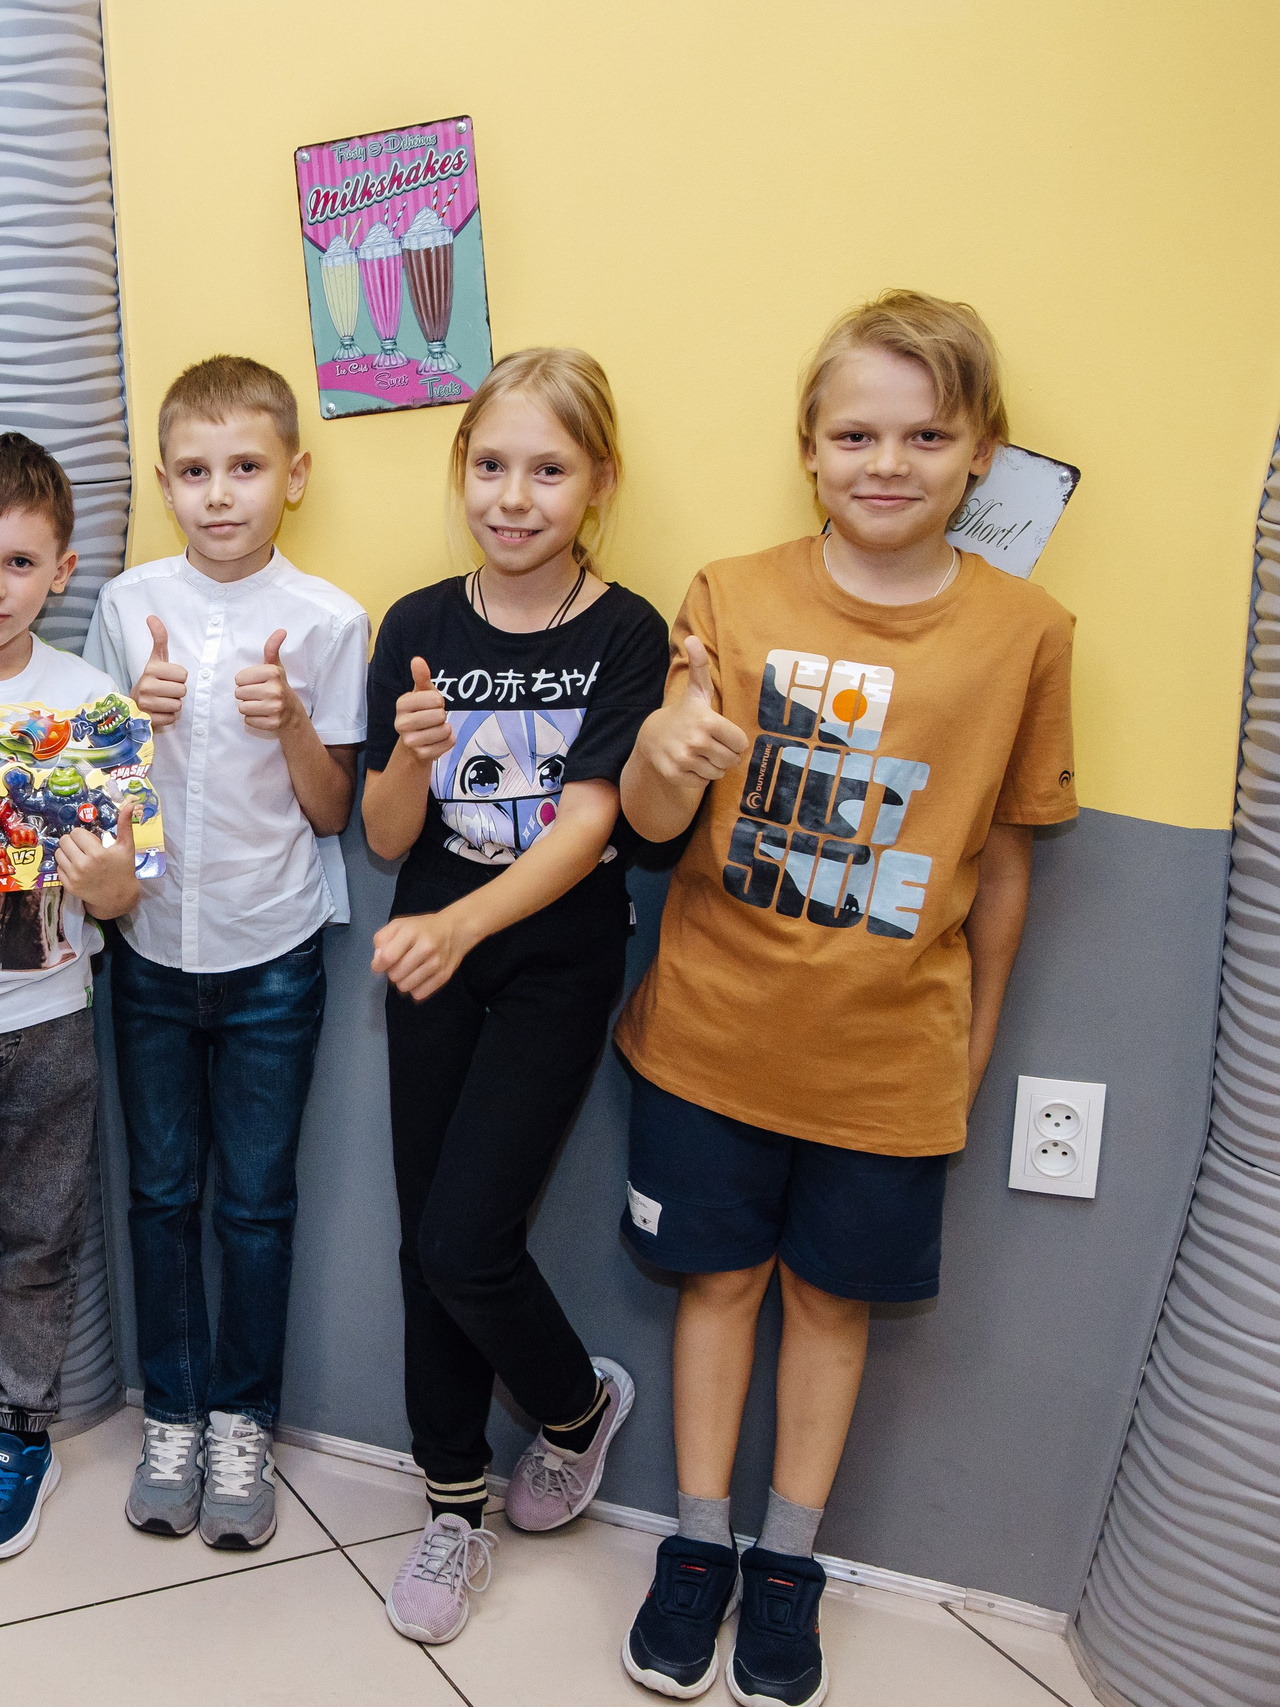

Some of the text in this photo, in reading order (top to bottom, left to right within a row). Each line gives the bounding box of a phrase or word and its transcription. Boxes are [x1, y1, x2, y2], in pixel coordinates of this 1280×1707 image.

[331, 133, 437, 163] Frosty & Delicious
[308, 148, 467, 221] Milkshakes
[348, 362, 369, 374] Cold
[374, 372, 409, 390] Sweet
[419, 375, 462, 399] Treats
[949, 498, 1032, 551] Short!
[758, 649, 895, 751] GO
[110, 763, 152, 780] SMASH!
[755, 743, 773, 791] OUTVENTURE
[740, 734, 931, 845] OUT
[12, 849, 35, 866] VS
[723, 817, 933, 939] SIDE
